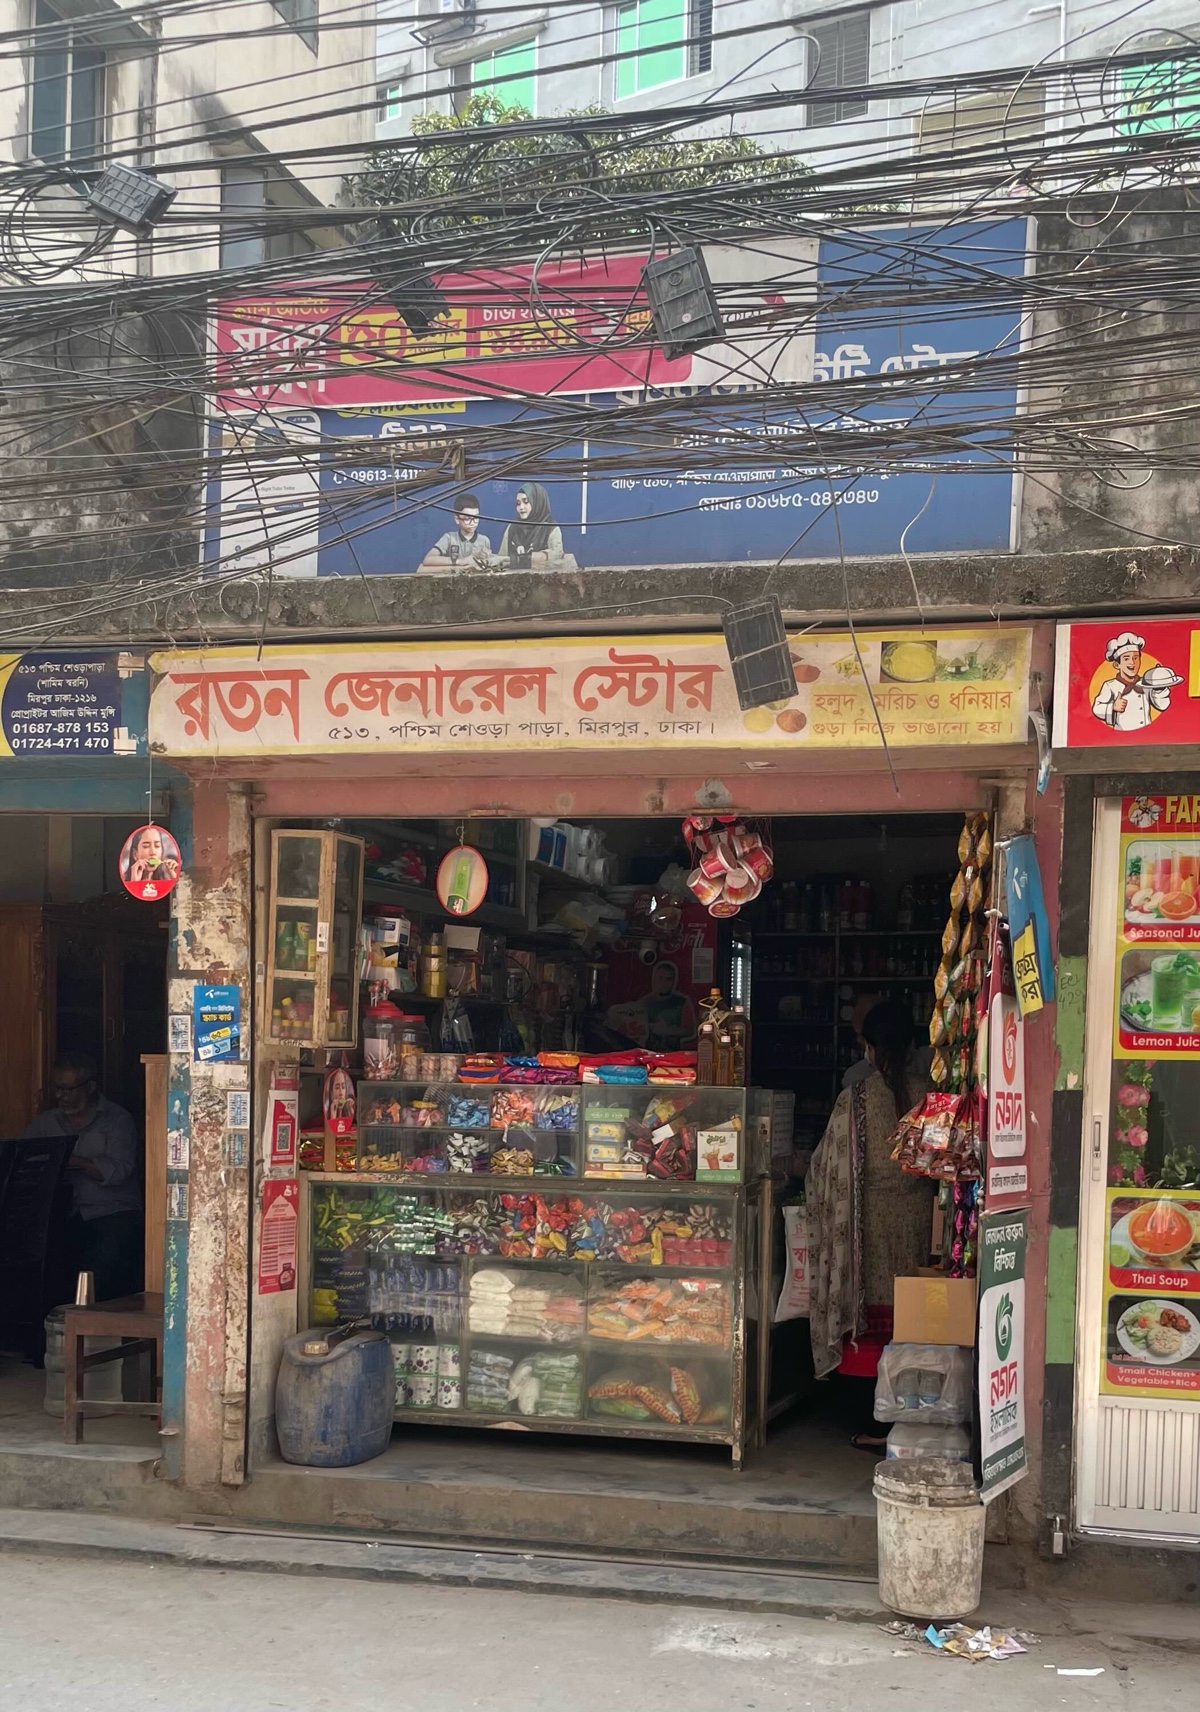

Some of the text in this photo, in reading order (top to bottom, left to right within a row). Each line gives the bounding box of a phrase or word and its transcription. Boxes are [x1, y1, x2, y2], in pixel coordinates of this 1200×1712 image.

[39, 661, 61, 673] পশ্চিম
[27, 692, 97, 705] মিরপুর ঢাকা-১২১৬
[168, 647, 724, 742] রতন জেনারেল স্টোর
[873, 687, 918, 711] মরিচ
[926, 694, 940, 709] ও
[949, 686, 1013, 711] ধনিয়ার
[49, 706, 75, 718] আজিম
[12, 722, 109, 734] 01687-878 153
[389, 721, 442, 738] পশ্চিম
[449, 722, 510, 738] শেওড়া
[12, 737, 109, 749] 01724-471 470
[1130, 928, 1184, 937] Seasonal
[1132, 1036, 1172, 1046] Lemon
[995, 1092, 1022, 1131] নগদ
[1005, 1223, 1024, 1242] করুন
[1132, 1273, 1188, 1287] Thai Soup
[1118, 1367, 1196, 1378] Small Chicken+
[990, 1361, 1017, 1406] নগদ
[1117, 1376, 1198, 1388] Vegetable+Rice
